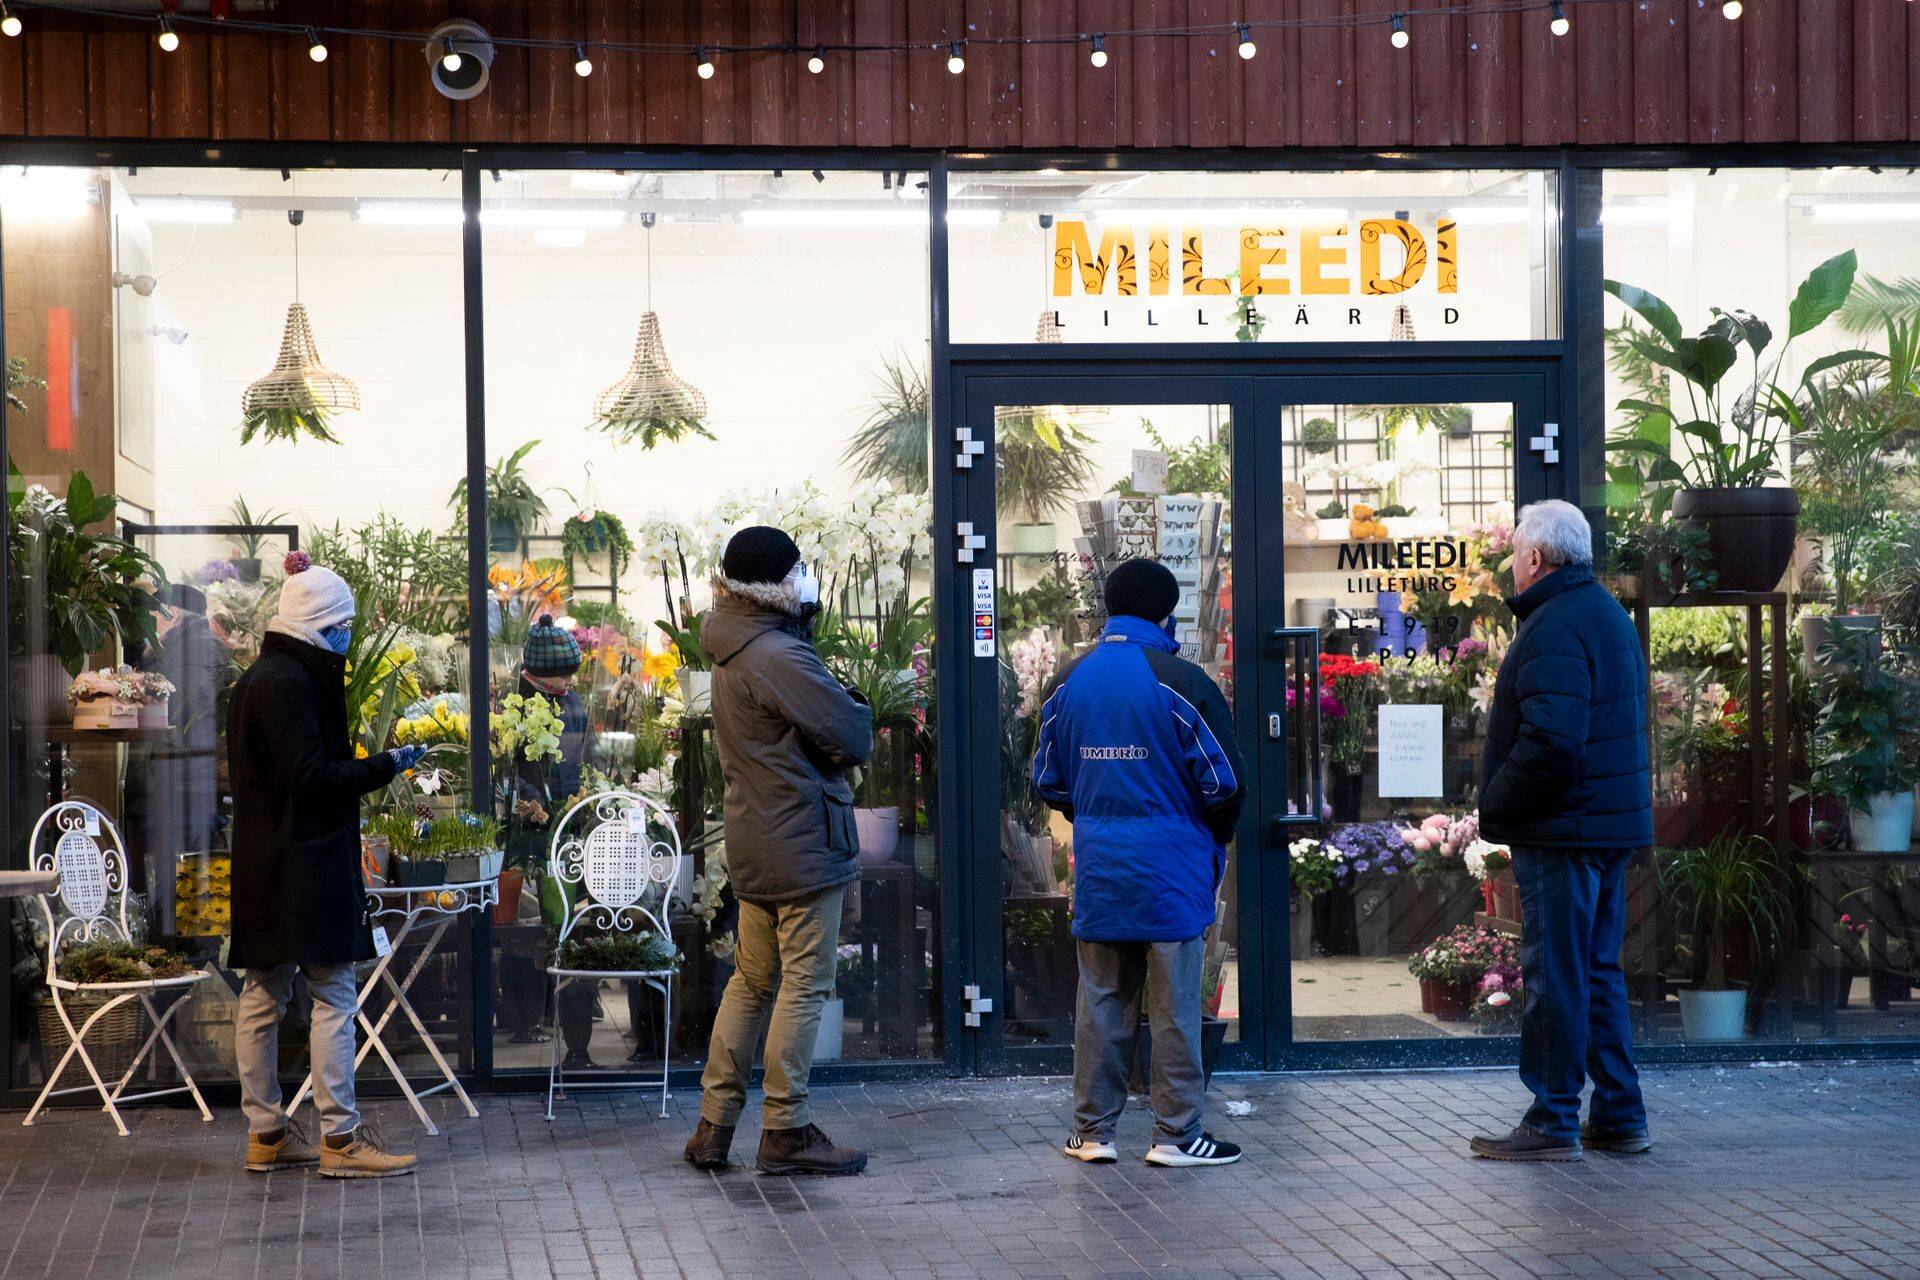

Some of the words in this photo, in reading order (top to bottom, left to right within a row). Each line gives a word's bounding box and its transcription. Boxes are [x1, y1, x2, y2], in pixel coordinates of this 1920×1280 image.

[1053, 219, 1458, 297] MILEEDI
[1054, 303, 1460, 328] LILLEÄRID
[1337, 541, 1466, 570] MILEEDI
[1347, 576, 1457, 593] LILLETURG
[1080, 745, 1149, 760] UMBRO
